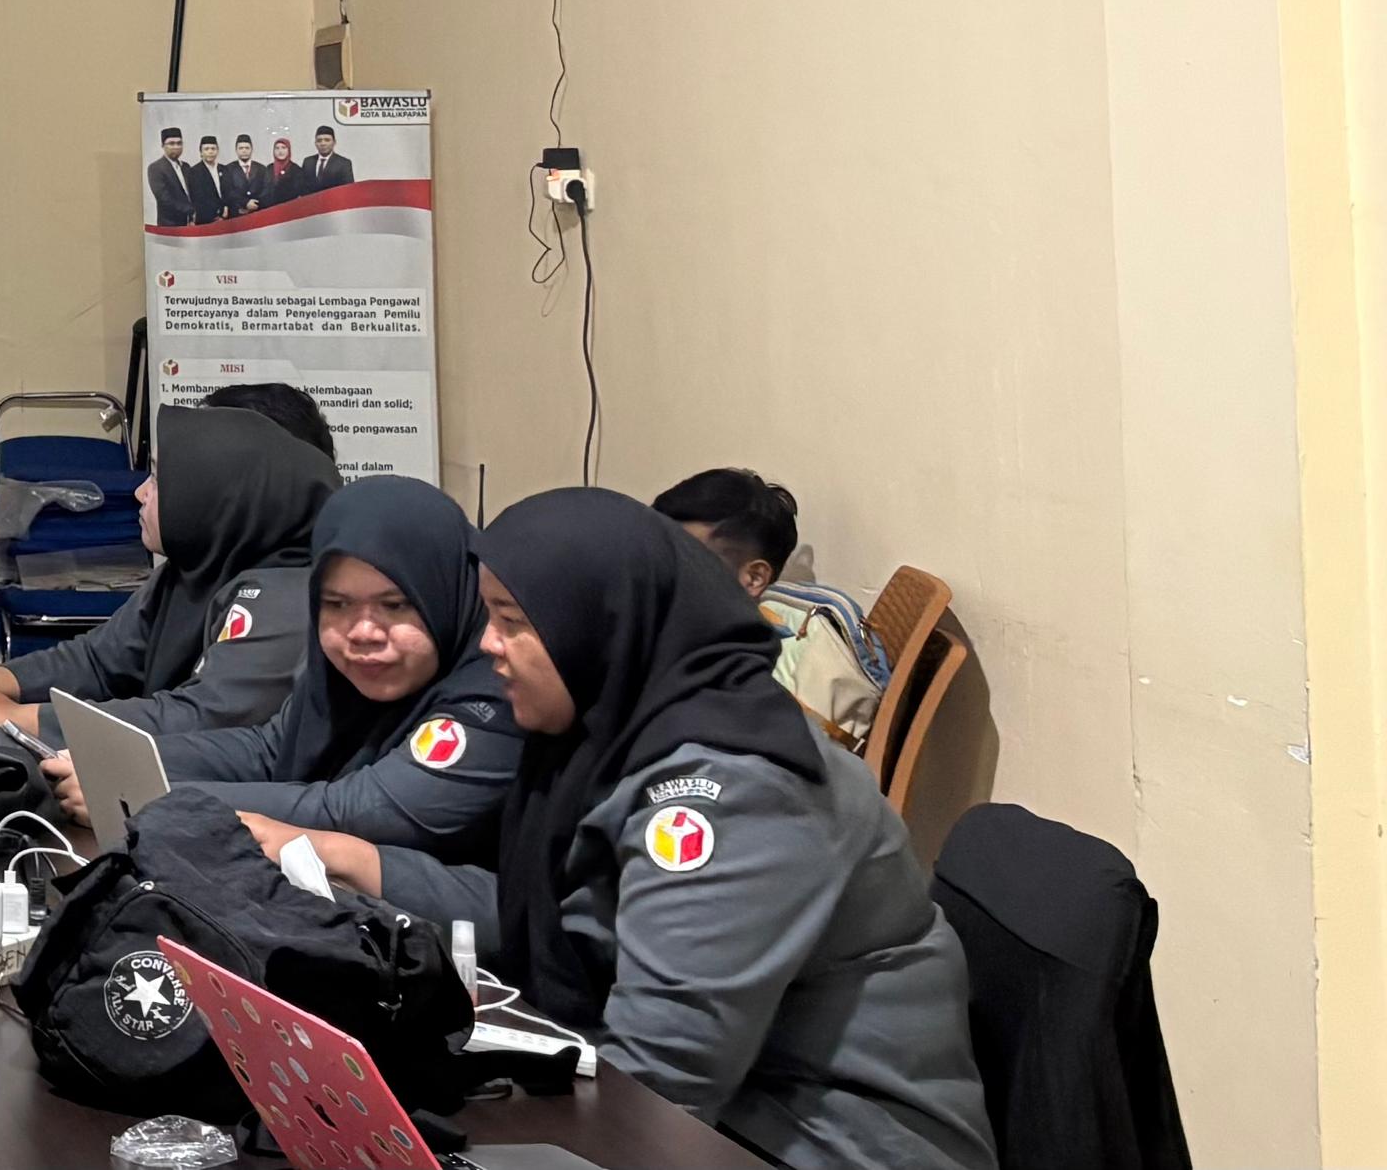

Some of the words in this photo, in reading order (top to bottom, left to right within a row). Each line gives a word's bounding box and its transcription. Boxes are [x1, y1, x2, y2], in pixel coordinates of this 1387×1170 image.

[360, 97, 427, 108] BAWASLU
[215, 275, 238, 284] VISI
[164, 296, 229, 306] Terwujudnya
[231, 296, 273, 305] Bawaslu
[275, 297, 316, 307] sebagai
[318, 297, 367, 307] Lembaga
[370, 297, 420, 307] Pengawal
[165, 308, 240, 319] Terpercayanya
[246, 309, 279, 318] dalam
[285, 309, 377, 319] Penyelenggaraan
[384, 310, 421, 319] Pemilu
[165, 321, 234, 332] Demokratis,
[242, 321, 314, 331] Bermartabat
[321, 322, 343, 331] dan
[350, 322, 421, 332] Berkualitas.
[220, 364, 245, 373] MISI
[161, 383, 169, 392] 1.
[303, 386, 373, 396] kelembagaan
[320, 399, 359, 408] mandiri
[362, 400, 381, 408] dan
[384, 400, 413, 410] solid;
[352, 424, 418, 435] pengawasan
[361, 462, 393, 471] dalam
[122, 1013, 155, 1031] STAR
